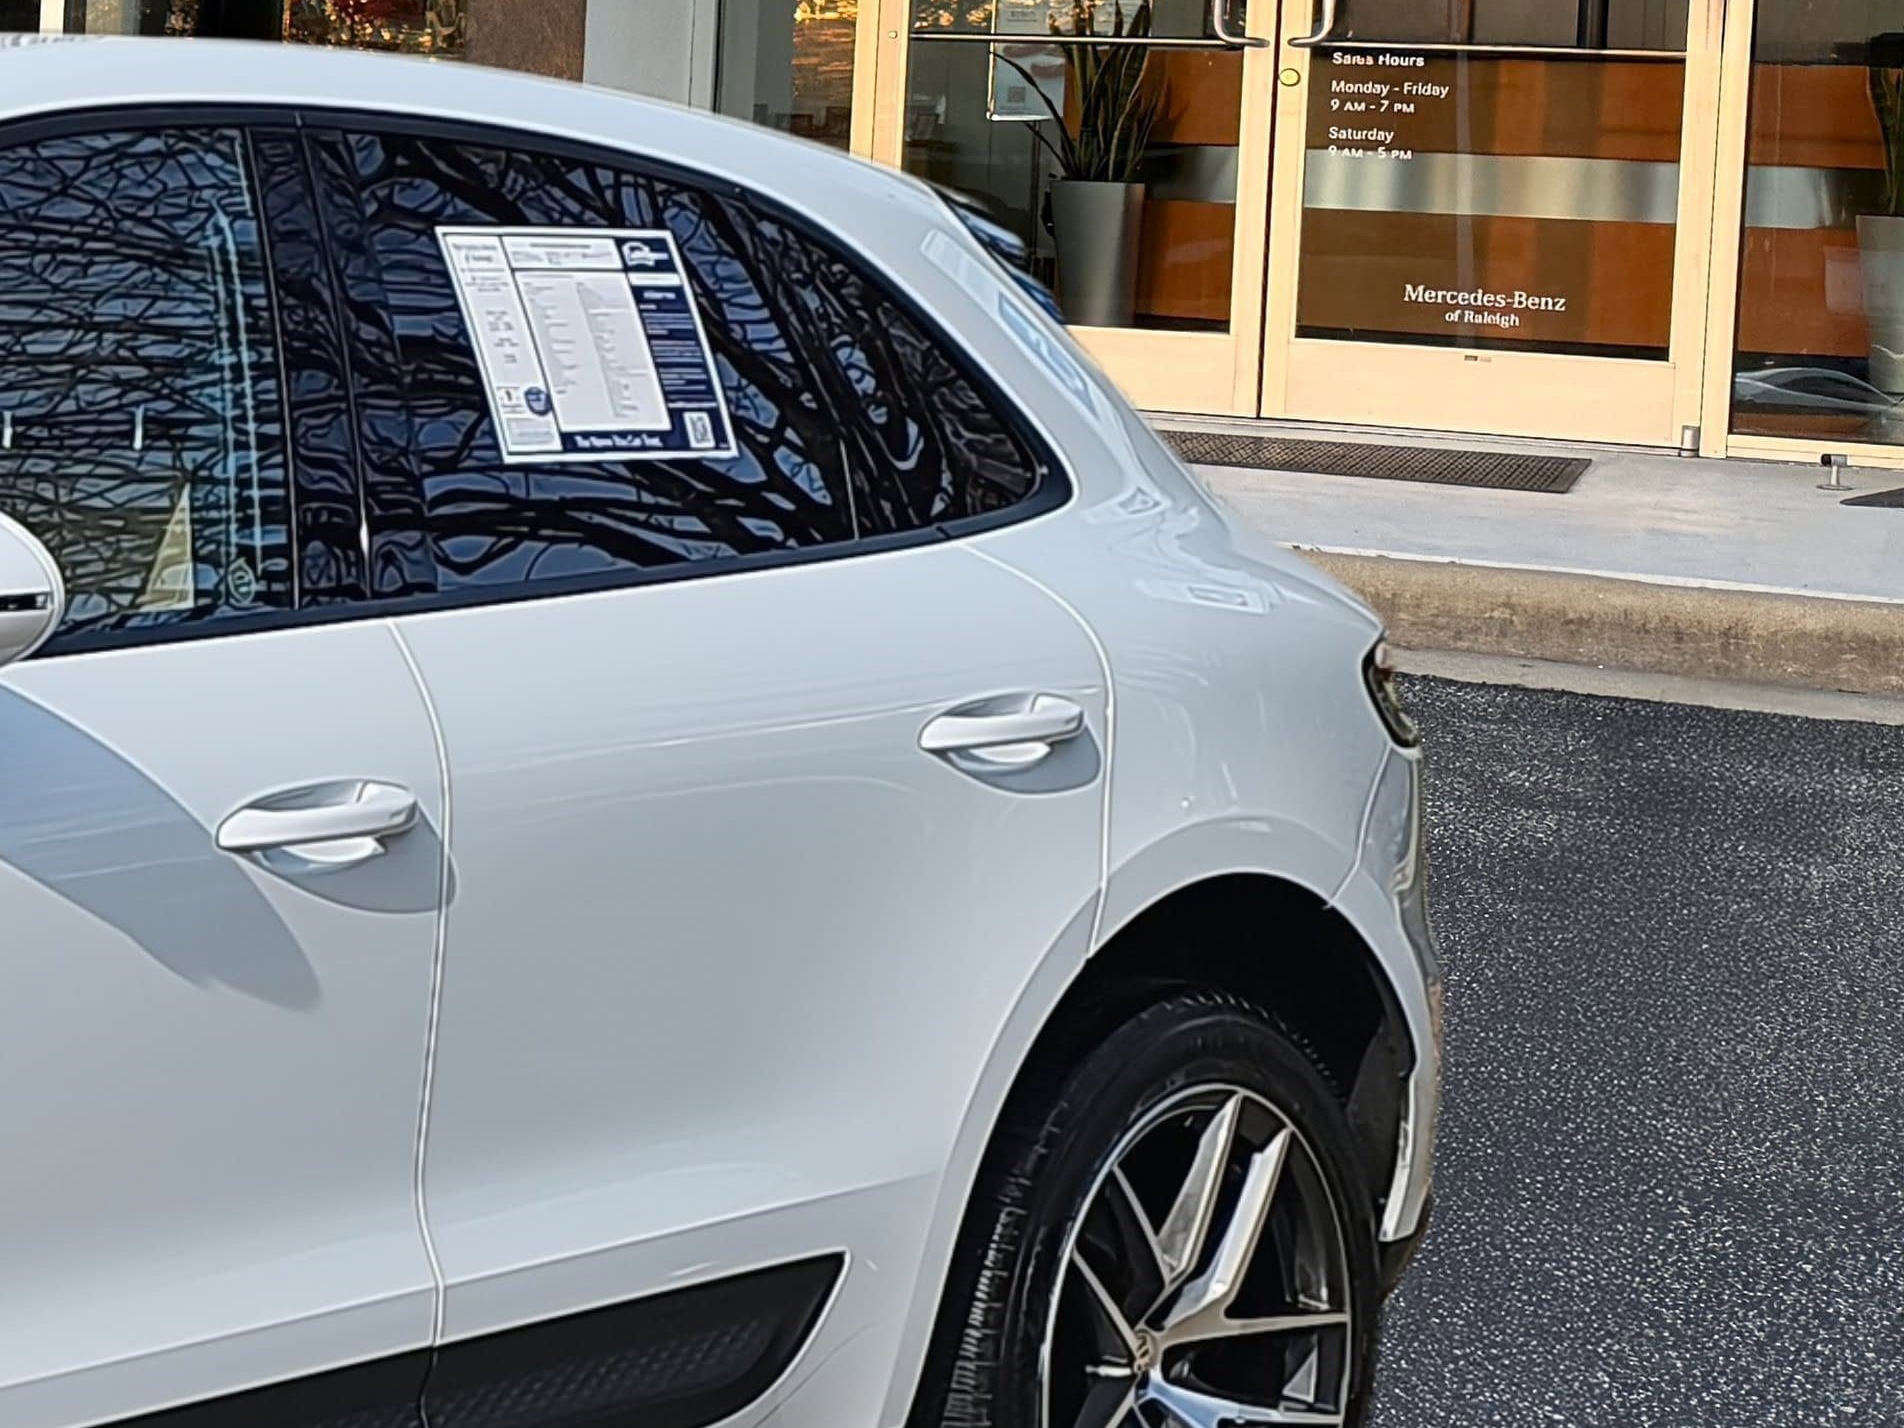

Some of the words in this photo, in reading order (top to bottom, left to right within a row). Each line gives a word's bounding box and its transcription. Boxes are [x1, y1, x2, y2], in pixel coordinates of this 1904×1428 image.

[1378, 53, 1425, 67] Hours
[1331, 79, 1390, 97] Monday
[1403, 81, 1449, 99] Friday
[1330, 98, 1340, 111] 9
[1343, 101, 1366, 112] AM
[1380, 99, 1389, 112] 7
[1393, 102, 1415, 113] PM
[1328, 126, 1394, 144] Saturday
[1328, 144, 1337, 157] 9
[1342, 147, 1364, 159] AM
[1377, 146, 1386, 159] 5
[1391, 149, 1412, 160] PM
[1403, 284, 1566, 312] Mercedes-Benz
[1445, 309, 1461, 322] of
[1463, 310, 1520, 329] Raleigh
